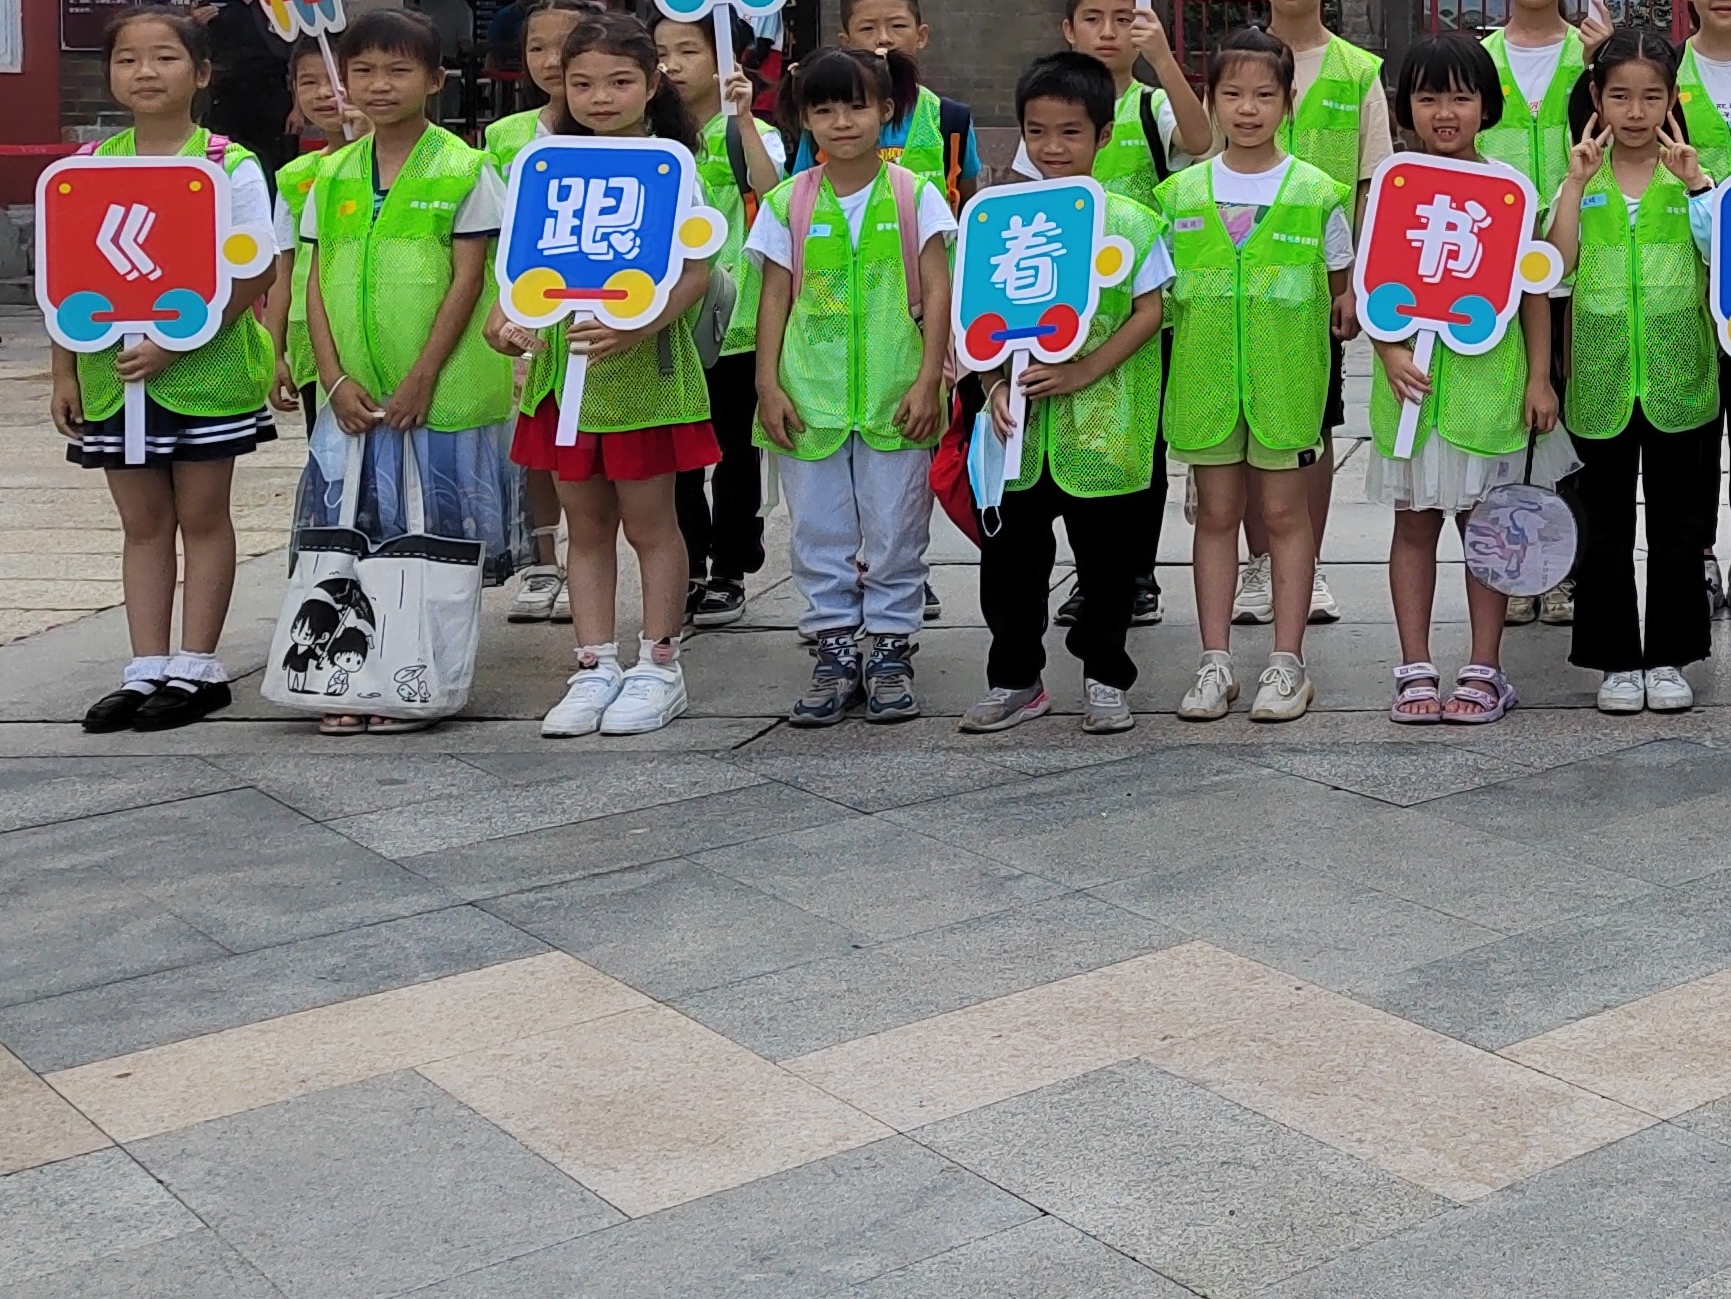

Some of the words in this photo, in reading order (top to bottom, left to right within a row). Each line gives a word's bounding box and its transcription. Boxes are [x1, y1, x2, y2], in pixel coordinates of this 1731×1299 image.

[537, 176, 646, 260] 跟
[990, 212, 1067, 305] 着
[1406, 193, 1491, 284] 书
